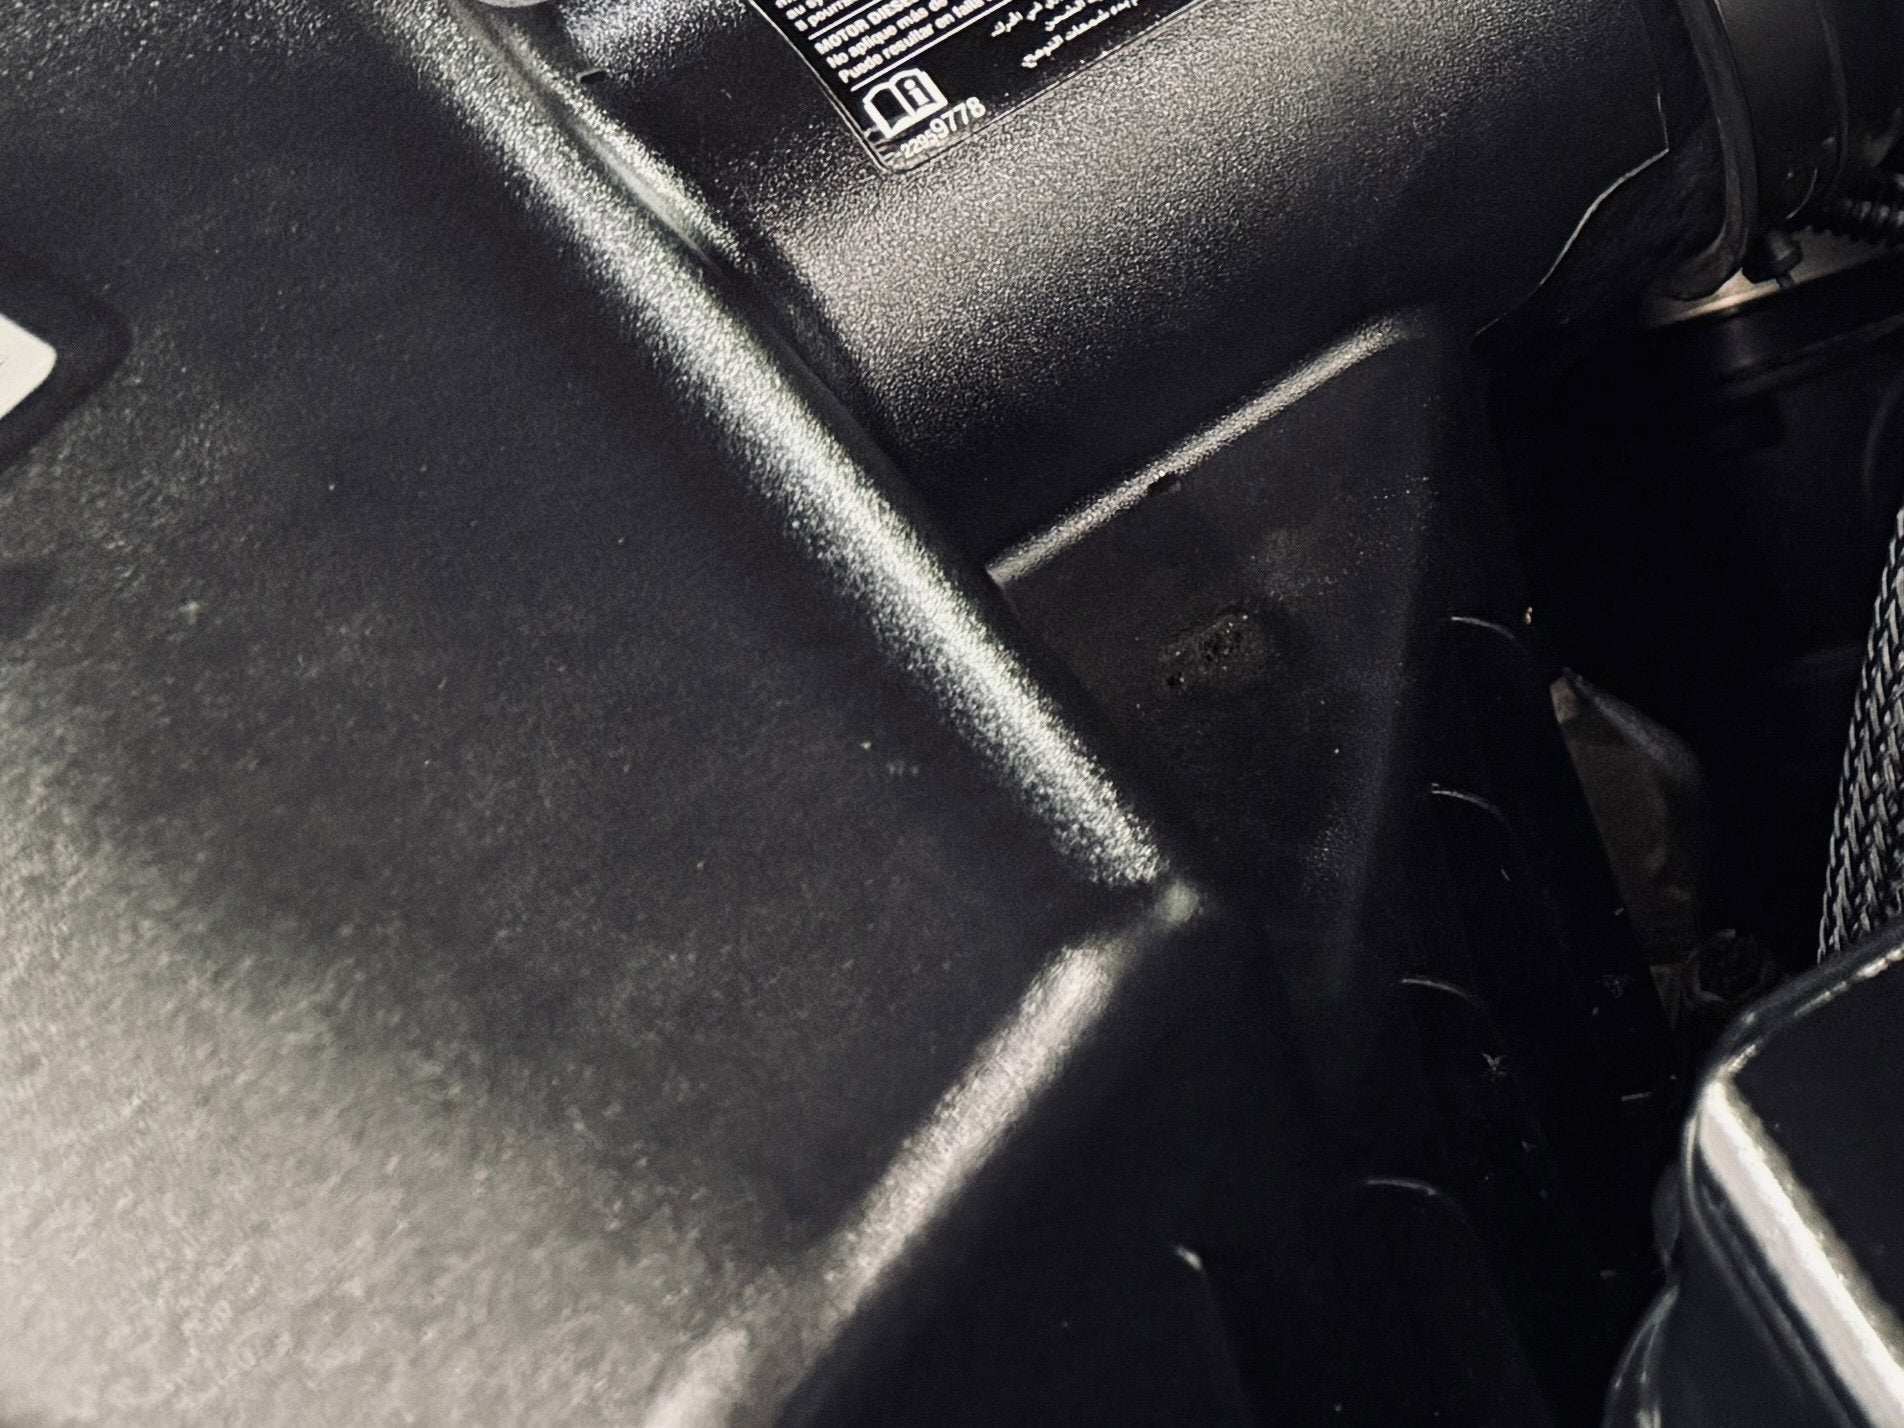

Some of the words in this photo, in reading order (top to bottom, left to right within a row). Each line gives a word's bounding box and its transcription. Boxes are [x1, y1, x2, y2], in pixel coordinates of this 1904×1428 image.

[786, 5, 806, 19] au
[794, 19, 808, 31] Il
[814, 19, 869, 53] MOTOR
[826, 52, 849, 68] No
[848, 25, 897, 57] aplique
[896, 7, 928, 29] más
[838, 54, 883, 82] Puede
[882, 23, 934, 58] resultar
[935, 13, 955, 28] en
[900, 97, 985, 158] 22959778
